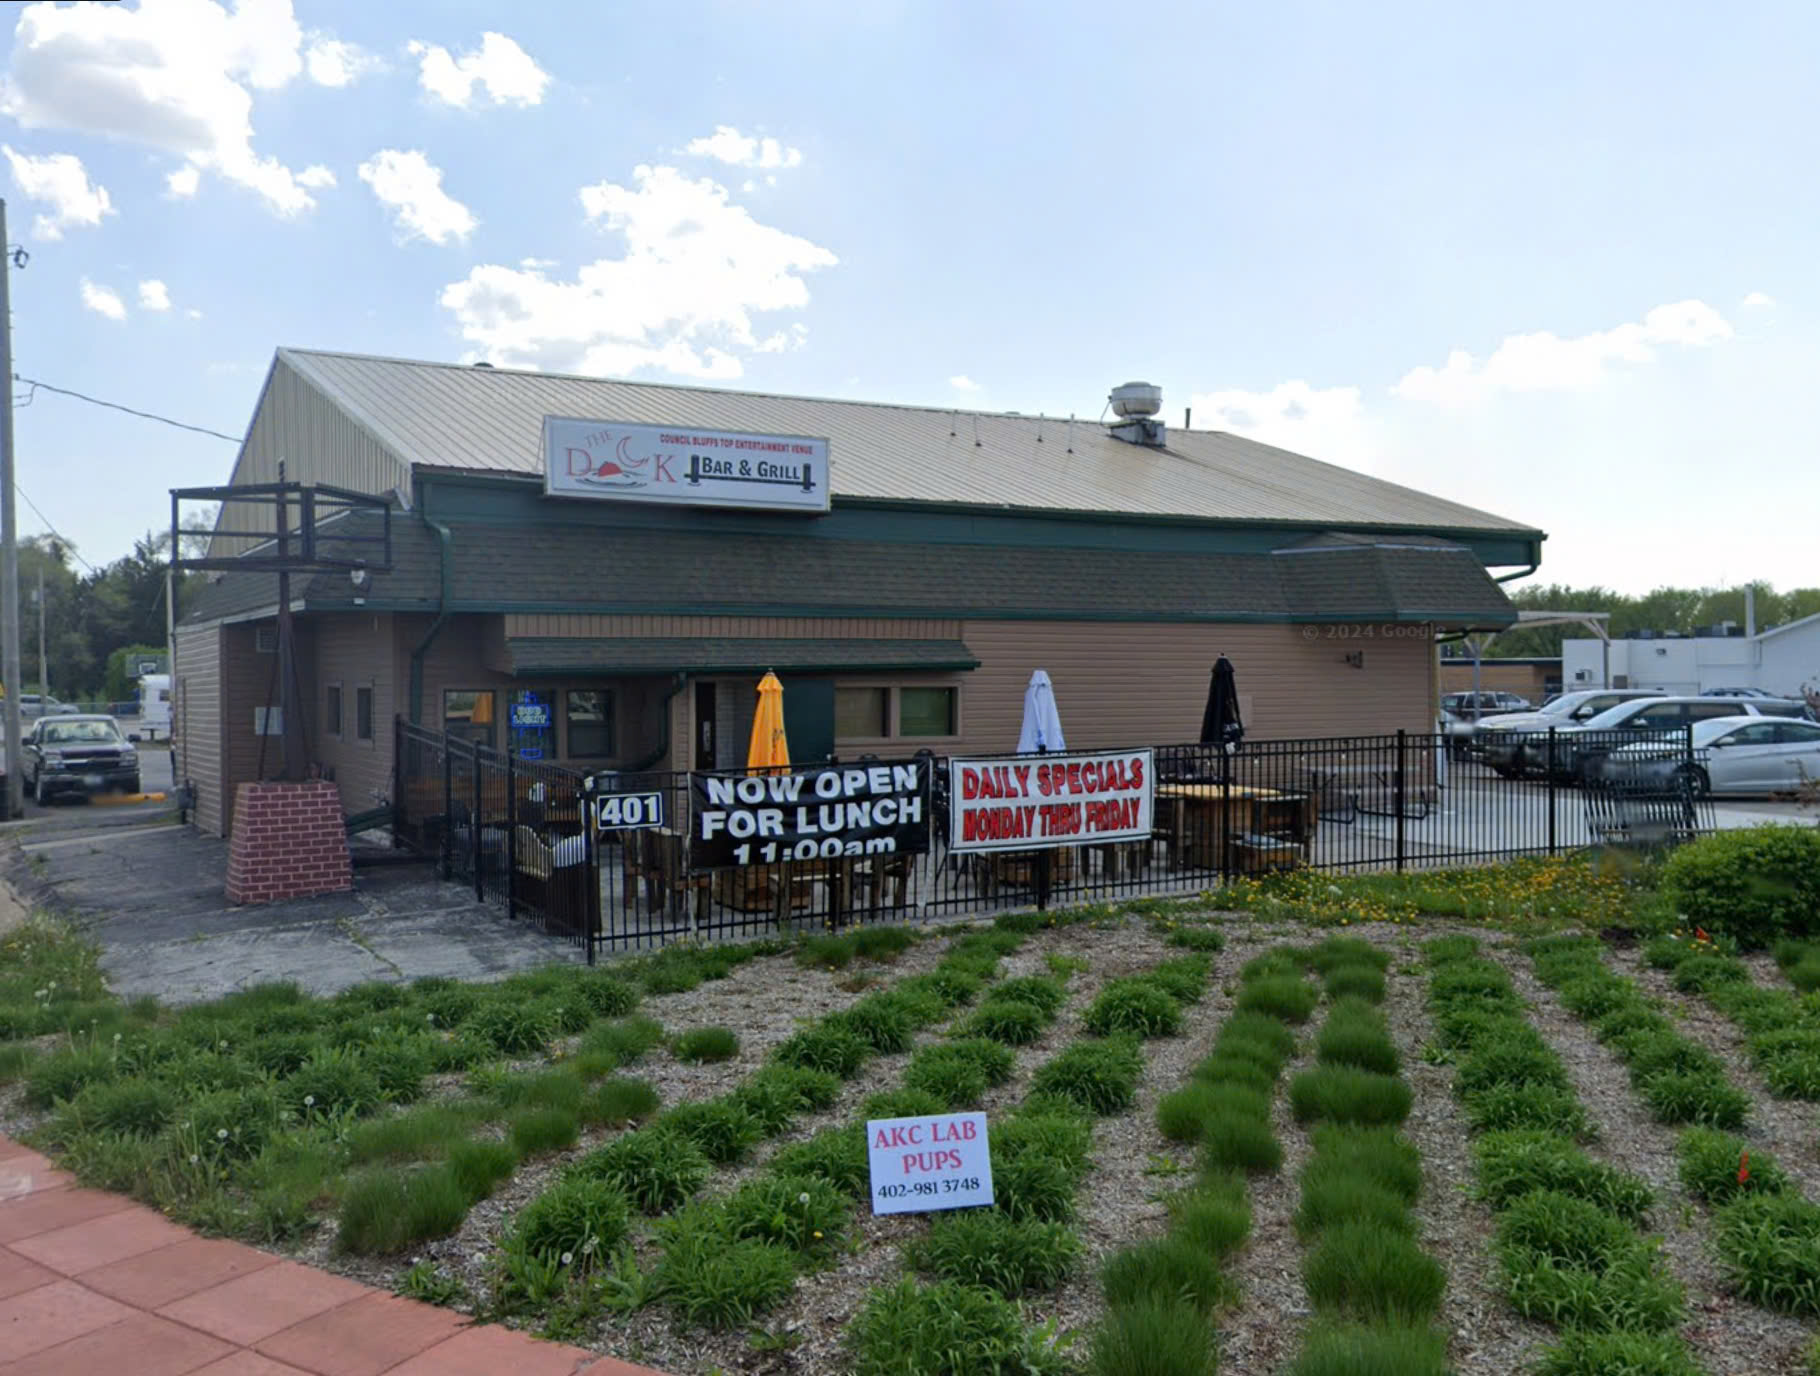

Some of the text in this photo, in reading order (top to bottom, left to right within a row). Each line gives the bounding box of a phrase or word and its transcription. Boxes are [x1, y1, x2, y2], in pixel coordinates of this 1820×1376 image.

[584, 430, 613, 448] THE
[660, 433, 813, 455] COUNCIL BLUFFS TOP ENTERTAINMENT VENUE
[739, 459, 752, 476] &
[707, 764, 918, 805] NOW OPEN
[961, 757, 1143, 800] DAILY SPECIALS
[600, 797, 660, 825] 401
[702, 796, 922, 840] FOR LUNCH
[962, 797, 1141, 842] MONDAY THRU FRIDAY
[874, 1120, 977, 1149] AKC LAB
[902, 1148, 963, 1174] PUPS
[877, 1177, 980, 1199] 402-981 3748
